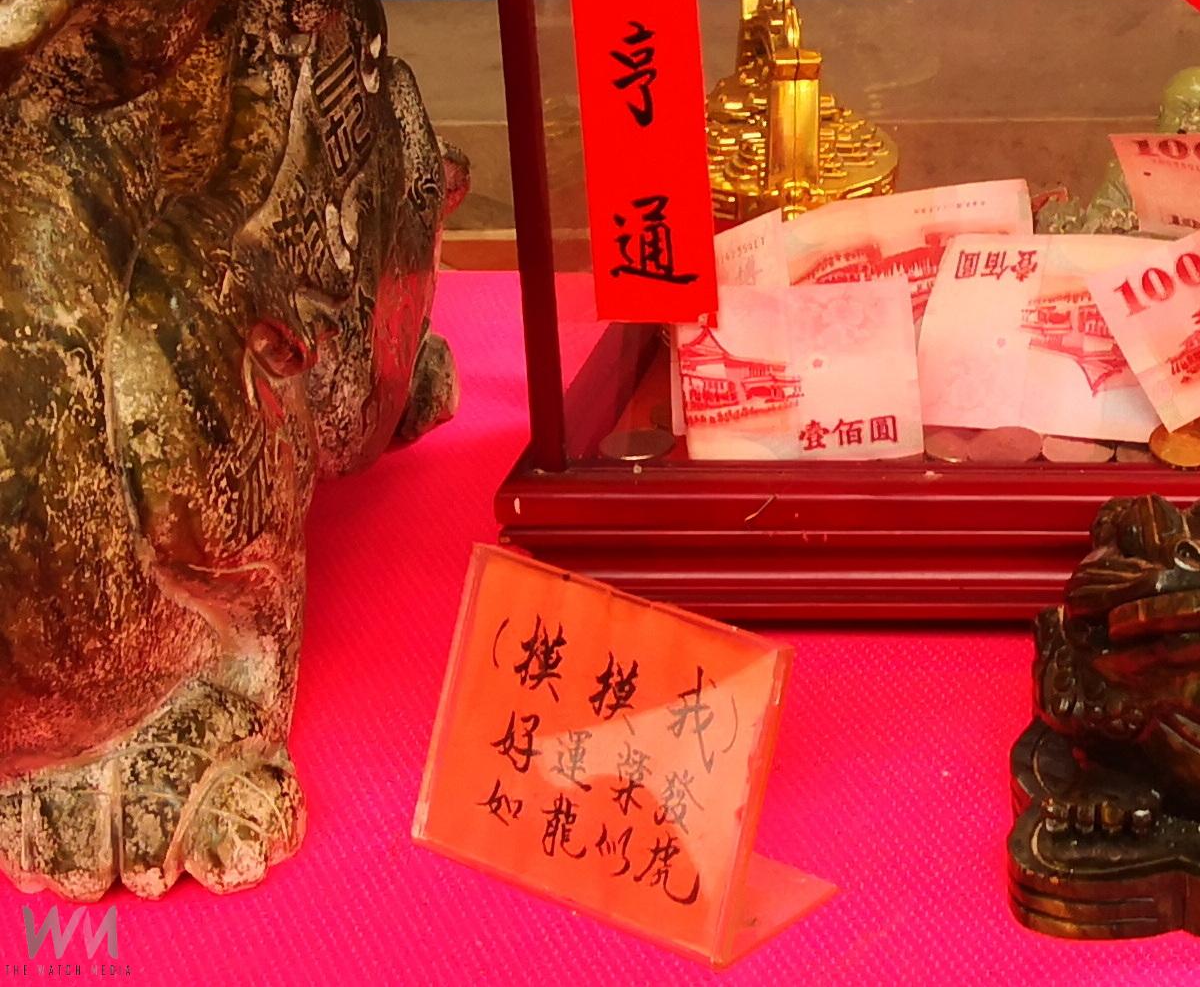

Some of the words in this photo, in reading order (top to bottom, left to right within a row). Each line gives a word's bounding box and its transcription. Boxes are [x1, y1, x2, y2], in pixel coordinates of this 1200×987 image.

[954, 249, 1040, 283] 壹佰圓
[798, 415, 898, 451] 壹佰圓
